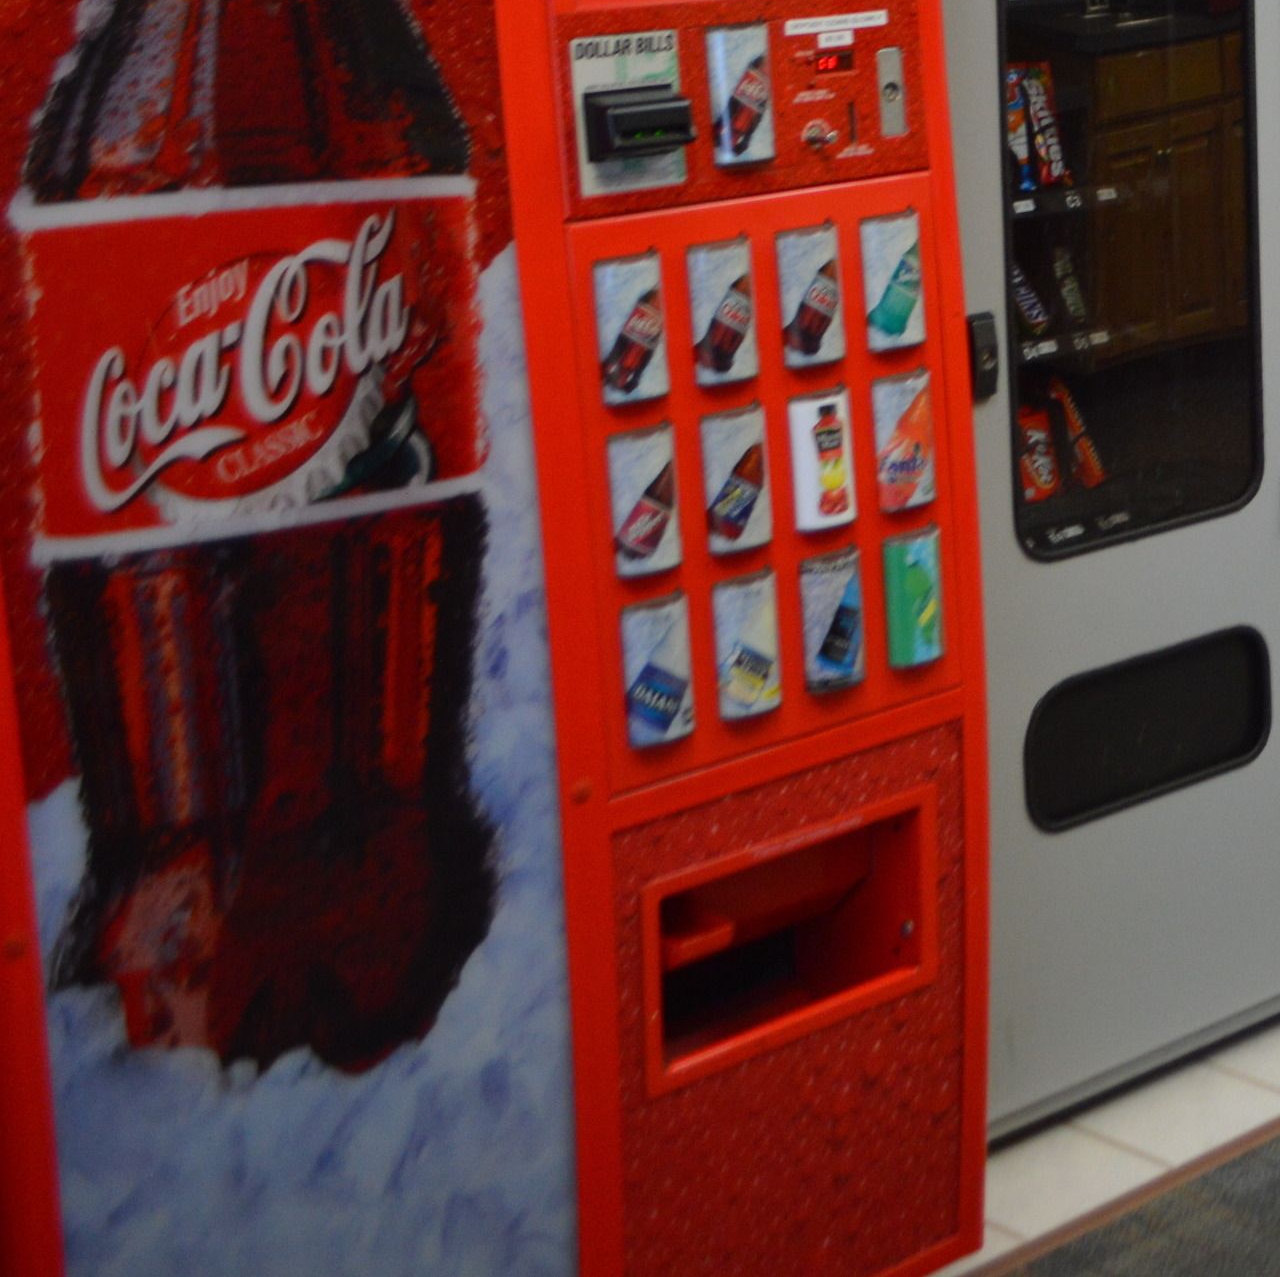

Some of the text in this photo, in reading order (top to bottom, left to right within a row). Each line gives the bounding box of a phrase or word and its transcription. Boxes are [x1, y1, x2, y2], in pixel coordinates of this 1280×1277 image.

[574, 33, 675, 61] DOLLAR BILLS
[174, 258, 250, 326] Enjoy
[80, 207, 411, 512] Coca-Cola
[215, 410, 327, 484] CLASSIC
